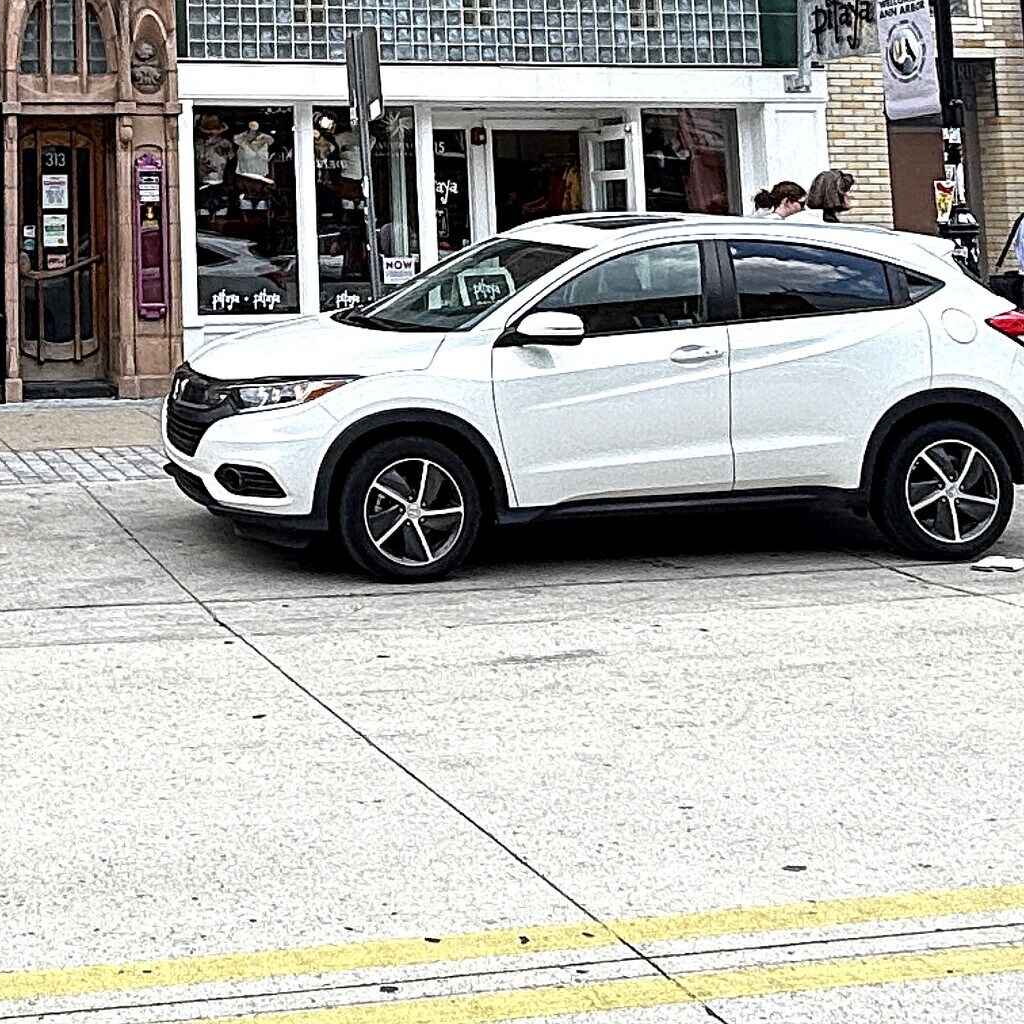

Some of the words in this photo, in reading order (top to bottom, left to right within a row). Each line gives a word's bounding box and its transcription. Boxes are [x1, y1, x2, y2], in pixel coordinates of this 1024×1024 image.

[879, 7, 897, 19] ANN
[899, 0, 925, 15] ARBOR
[45, 152, 66, 167] 313
[434, 179, 458, 205] aya
[385, 260, 413, 270] NOW
[212, 288, 240, 311] pitaya
[252, 288, 281, 310] pitaya
